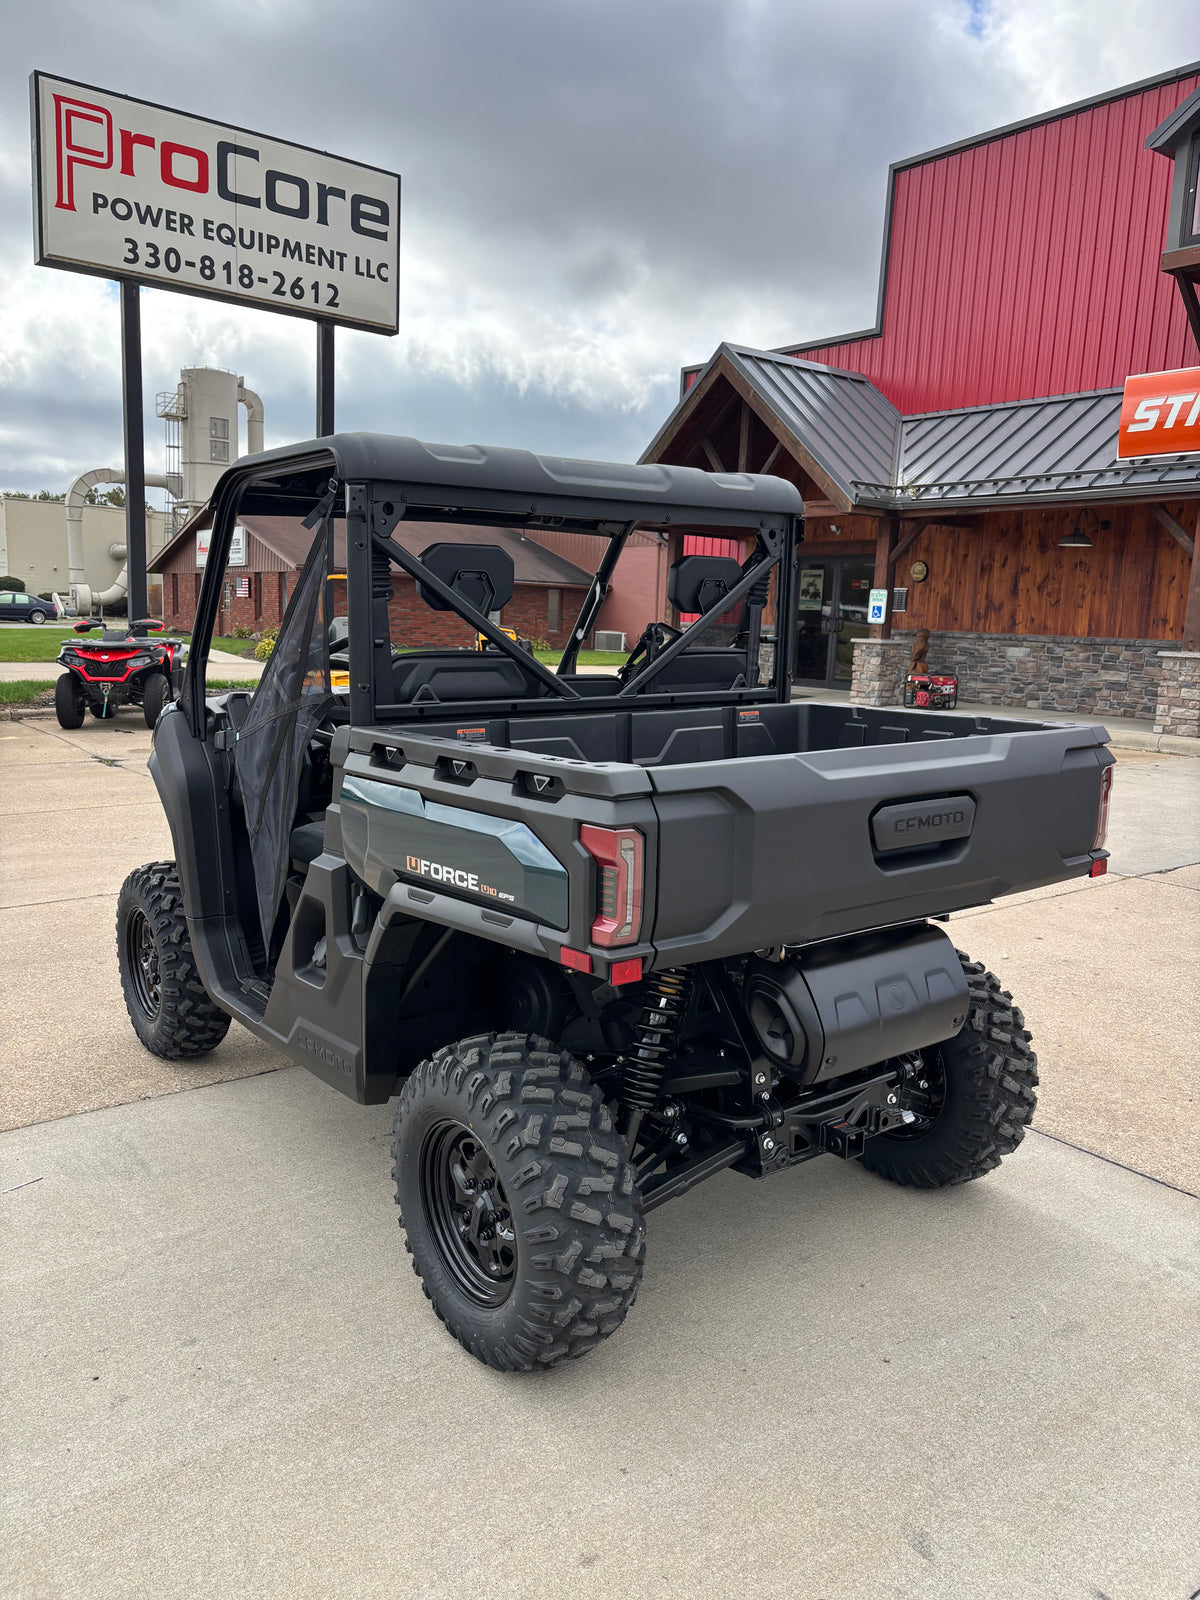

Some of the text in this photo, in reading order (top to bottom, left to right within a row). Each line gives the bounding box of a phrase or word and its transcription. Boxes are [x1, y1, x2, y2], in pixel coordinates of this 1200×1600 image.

[52, 93, 390, 241] ProCore
[92, 192, 389, 283] POWER EQUIPMENT LLC
[122, 237, 341, 308] 330-818-2612
[1126, 391, 1200, 433] STI
[894, 811, 965, 834] CFMOTO
